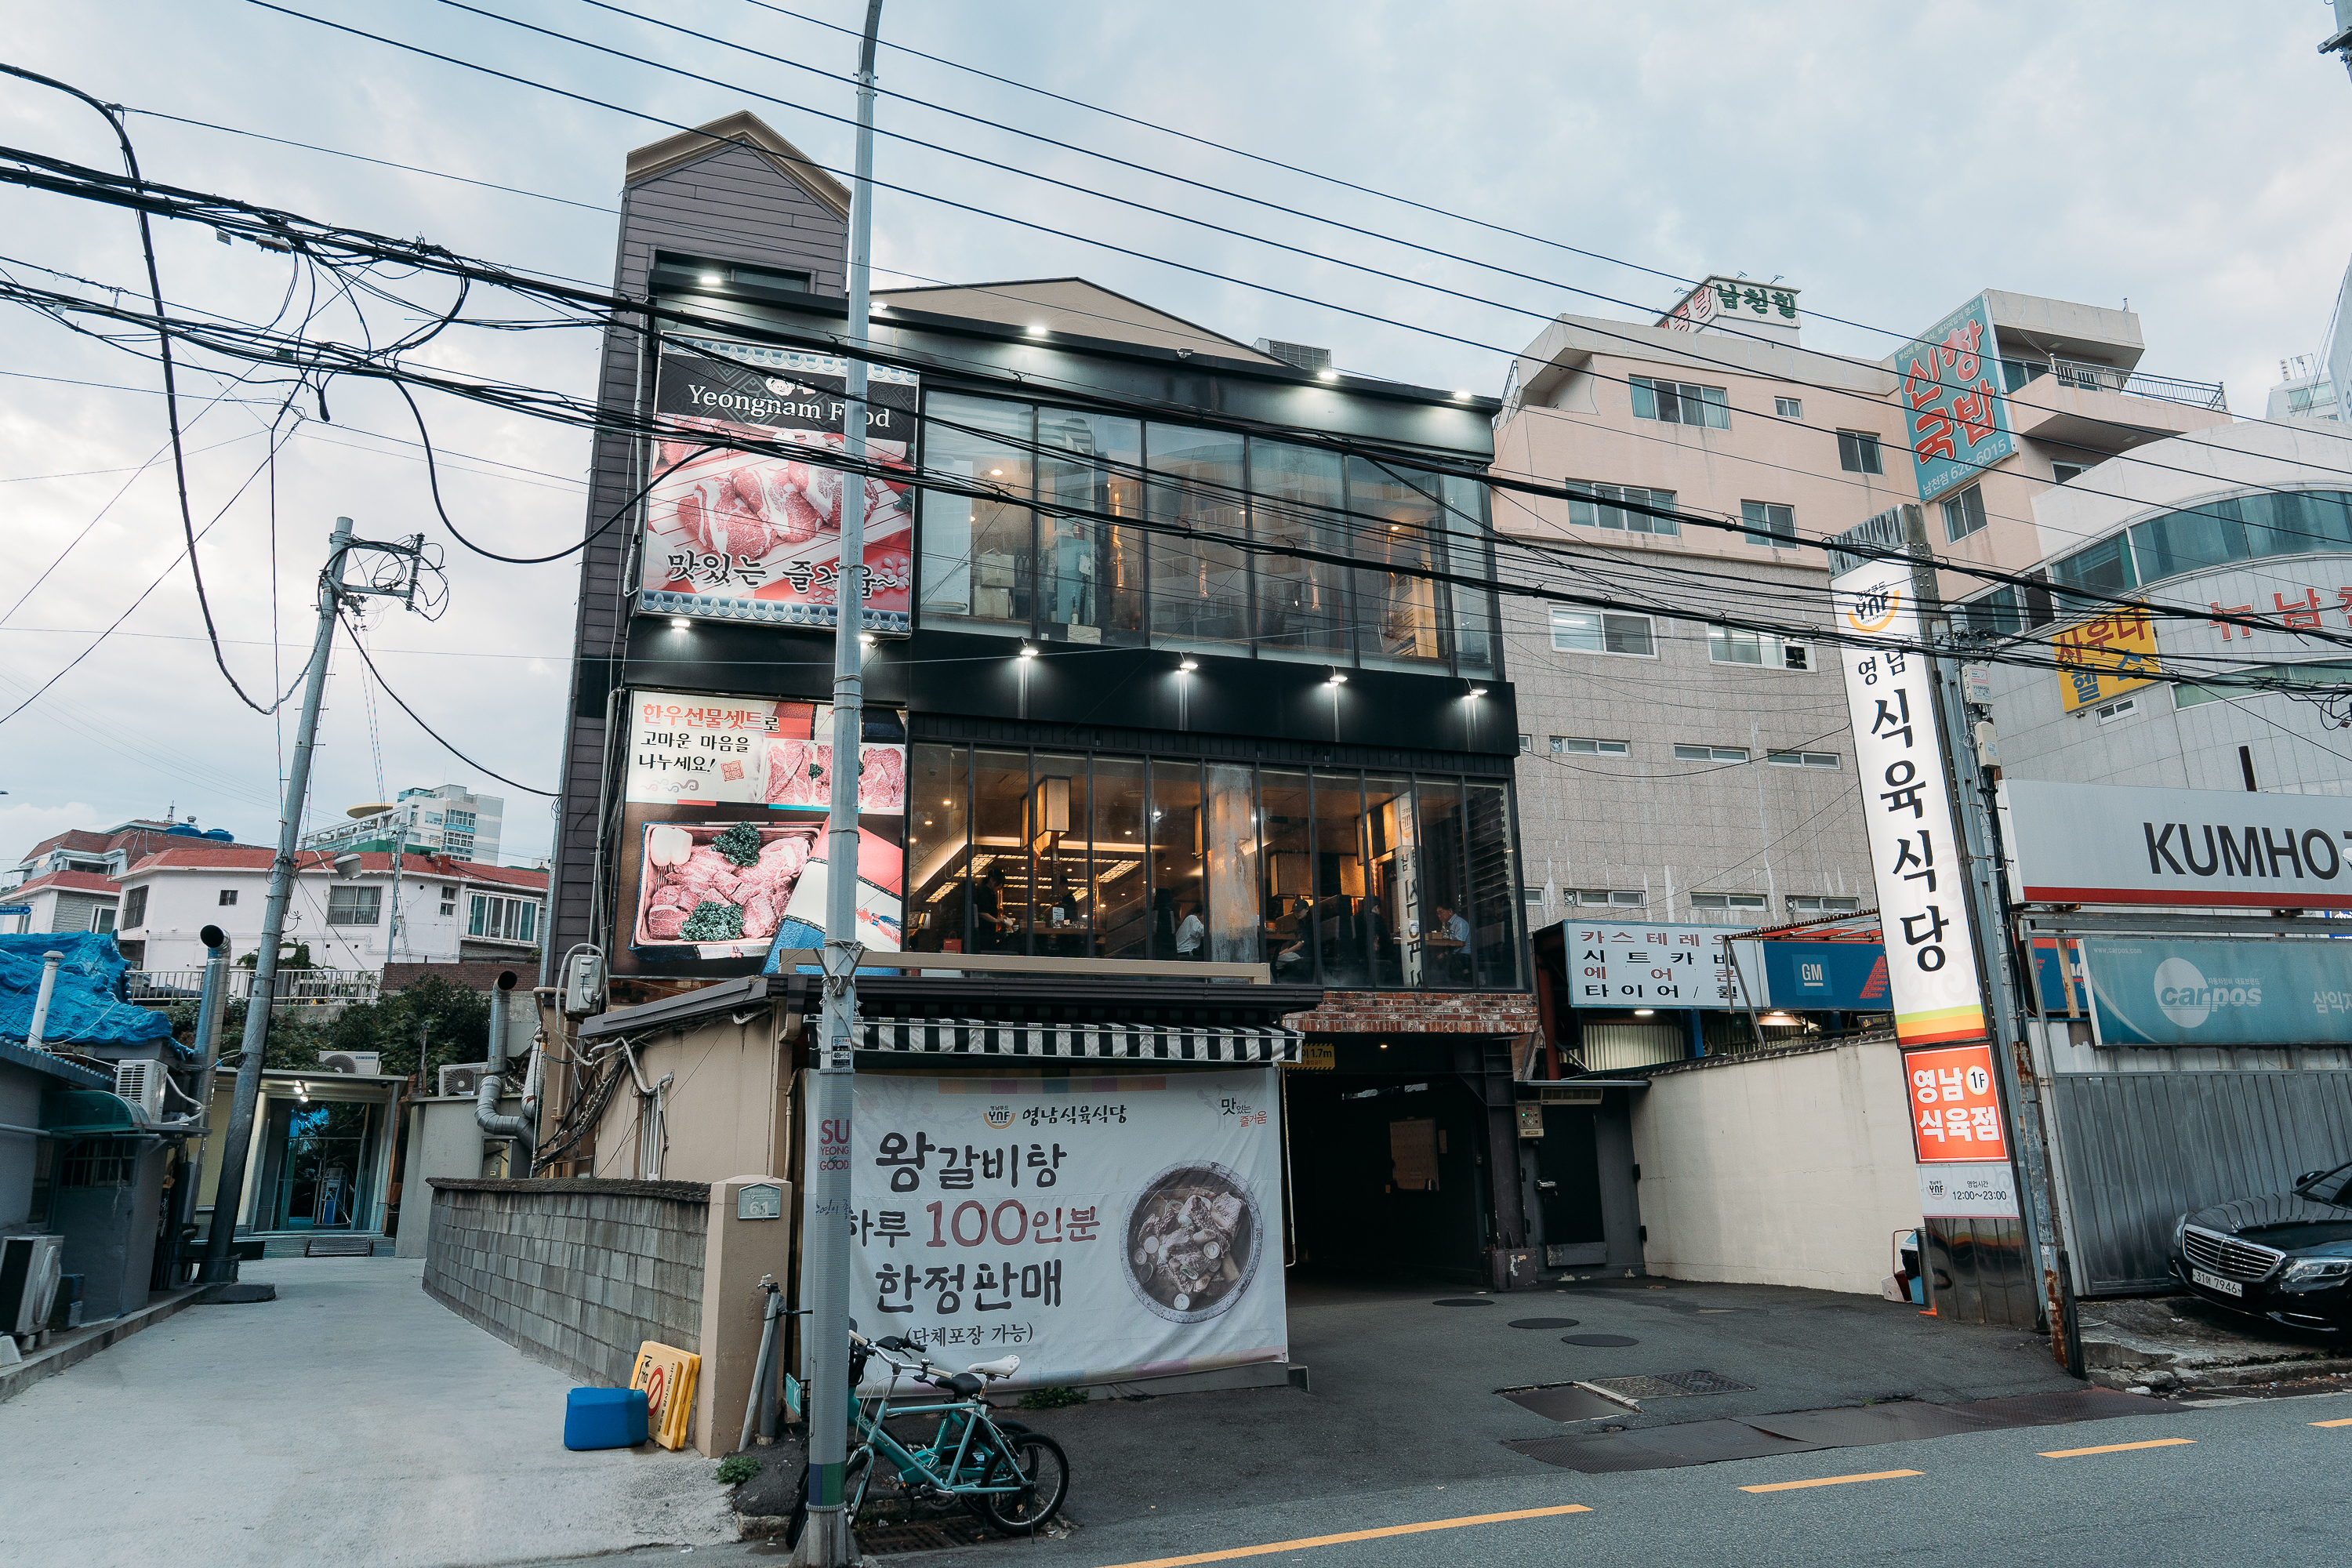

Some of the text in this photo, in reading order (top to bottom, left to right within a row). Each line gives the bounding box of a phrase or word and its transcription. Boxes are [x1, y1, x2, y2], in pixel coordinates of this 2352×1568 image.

[1904, 318, 1985, 412] 신창
[688, 383, 891, 429] Yeongnam Fod
[1915, 378, 1996, 465] 국밥
[1922, 438, 2007, 495] 남천점 626-6015
[668, 550, 767, 587] 맛있는
[2057, 608, 2146, 664] 사우나
[1858, 650, 1906, 686] 영남
[642, 703, 779, 731] 한우선물셋트로
[641, 730, 751, 753] 고마운 마음을
[638, 753, 716, 772] 나누세요!
[1871, 688, 1951, 972] 식육식당
[2143, 822, 2340, 880] KUMHO
[1801, 963, 1824, 982] GM
[2160, 984, 2263, 1012] carpos
[1310, 1048, 1332, 1058] 1.7m
[1913, 1066, 1986, 1104] 영남 1F
[1022, 1104, 1127, 1127] 영남식육식당
[1221, 1097, 1252, 1116] 맛있는
[1240, 1110, 1268, 1127] 즐거움
[820, 1119, 850, 1145] SU
[1918, 1105, 2001, 1143] 식육점
[820, 1145, 849, 1156] YEONG
[875, 1131, 1068, 1193] 왕갈비탕
[819, 1160, 849, 1171] GOOD
[1952, 1190, 2007, 1200] 12:00~23:00
[1966, 1180, 1989, 1189] 영업시간
[924, 1199, 1102, 1249] 100인분
[875, 1258, 1062, 1315] 한정판매
[2196, 1271, 2238, 1294] 31어 7946
[905, 1321, 1034, 1348] (단체포장 가능)
